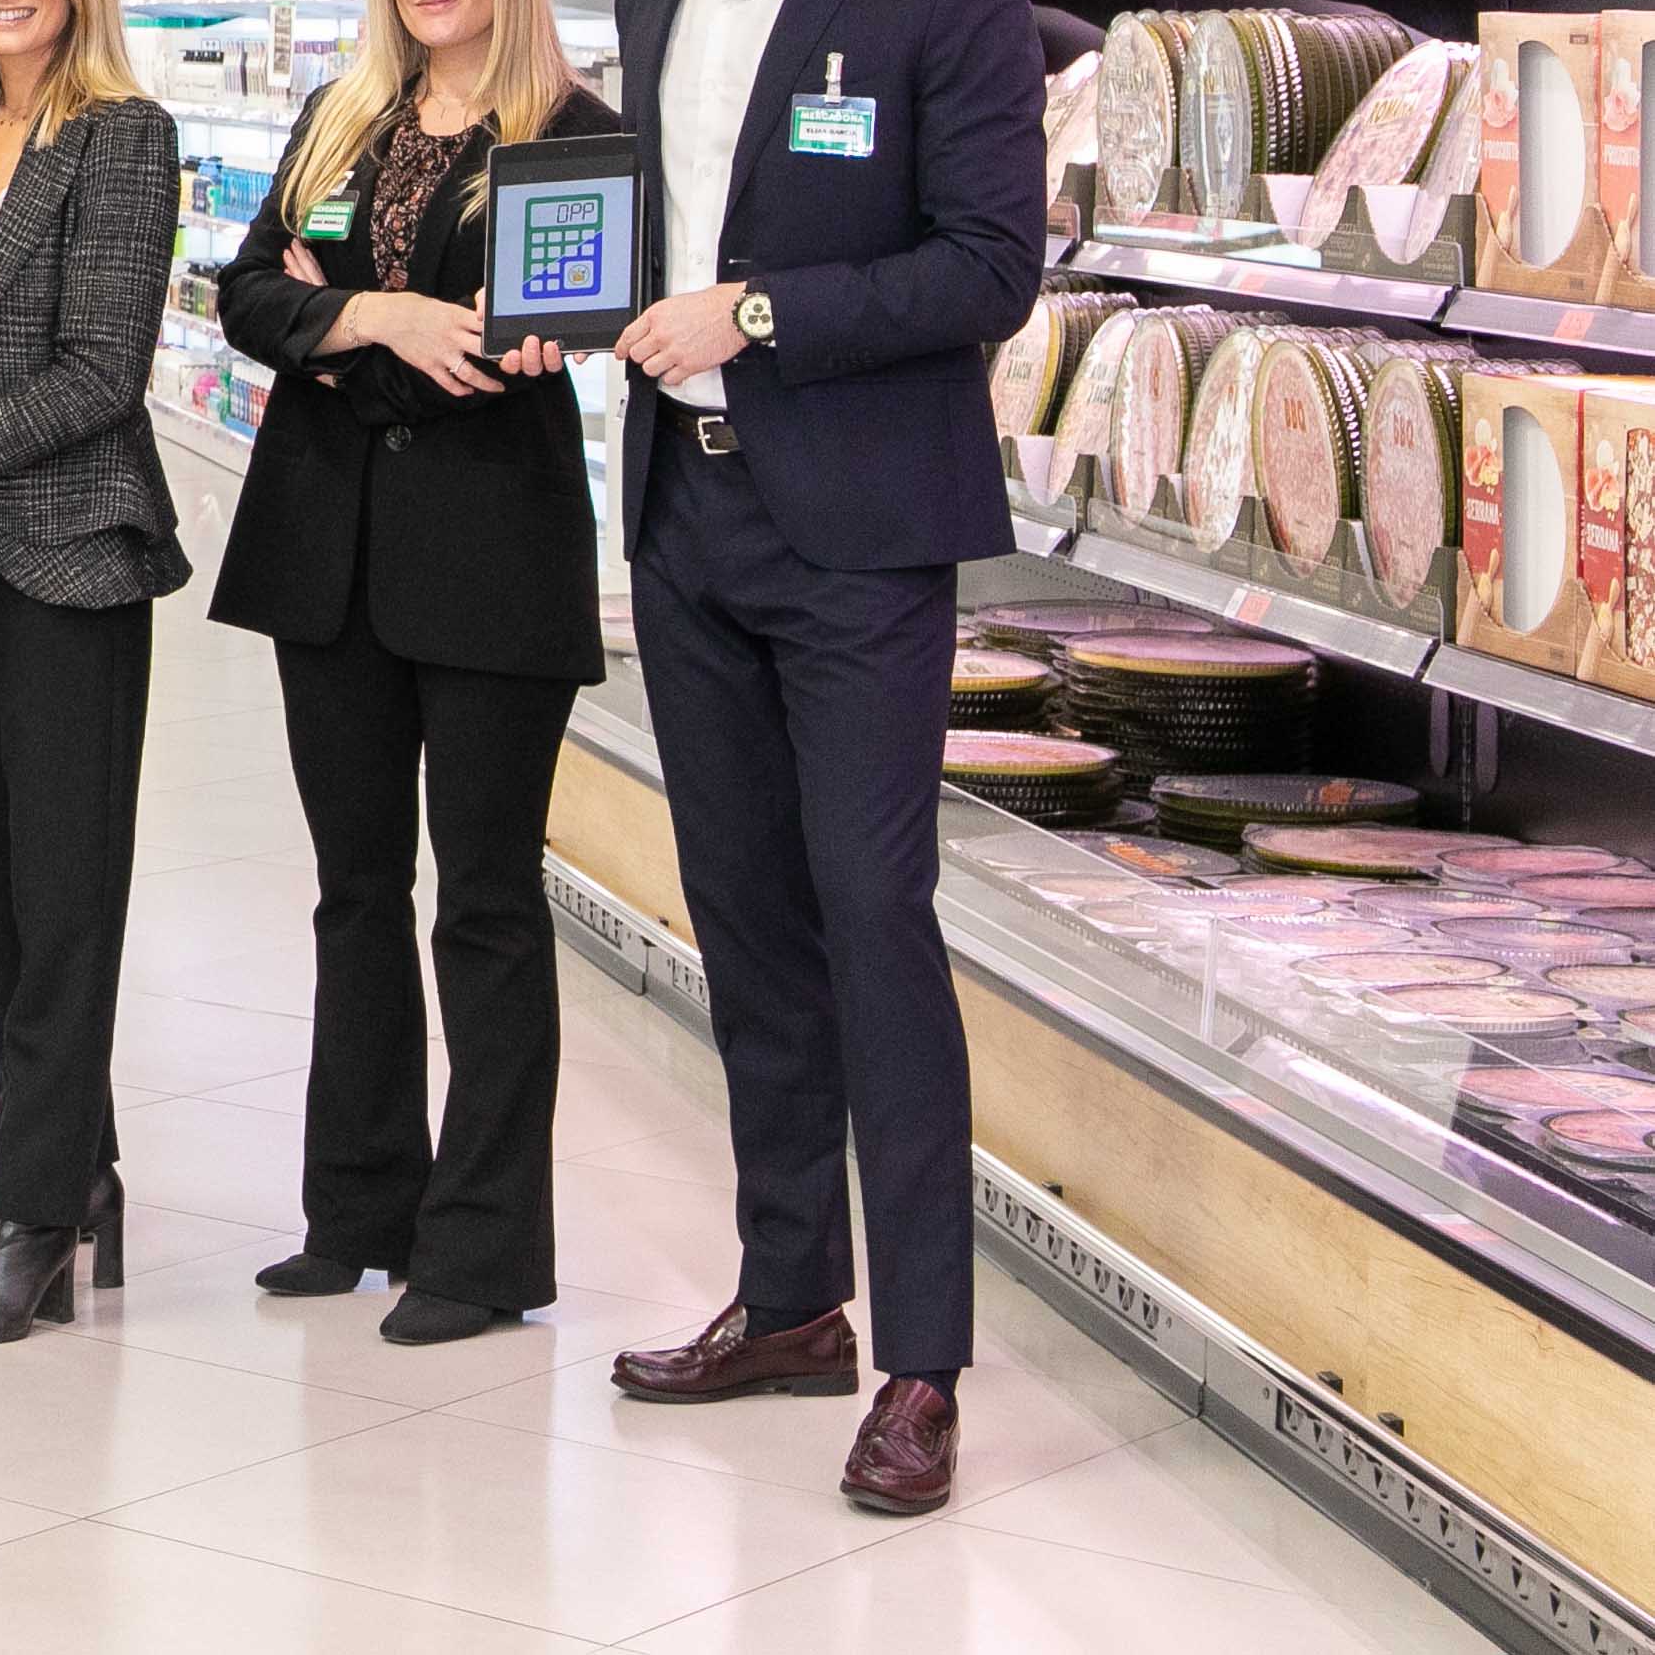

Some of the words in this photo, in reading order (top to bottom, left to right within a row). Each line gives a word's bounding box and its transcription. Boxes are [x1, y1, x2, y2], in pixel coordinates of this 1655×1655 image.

[801, 111, 865, 123] MERCADONA
[1284, 397, 1307, 433] BBQ
[1466, 497, 1499, 525] SERRANA
[1586, 522, 1619, 554] SERRANA
